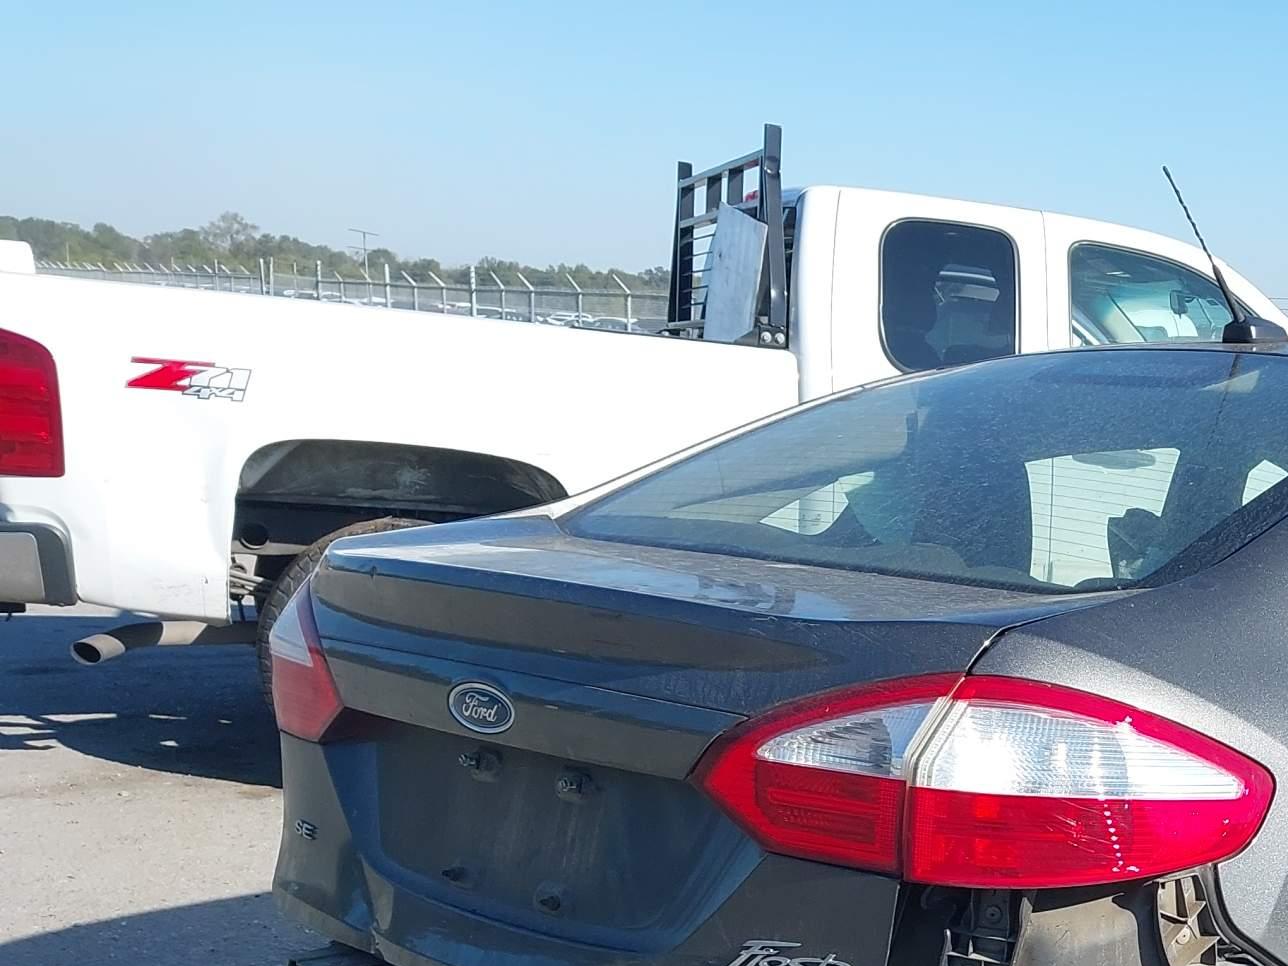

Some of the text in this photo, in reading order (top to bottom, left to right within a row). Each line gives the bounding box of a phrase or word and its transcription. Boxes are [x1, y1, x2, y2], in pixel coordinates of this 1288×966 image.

[125, 356, 252, 392] Z71
[462, 692, 499, 722] Ford
[295, 819, 314, 840] SE
